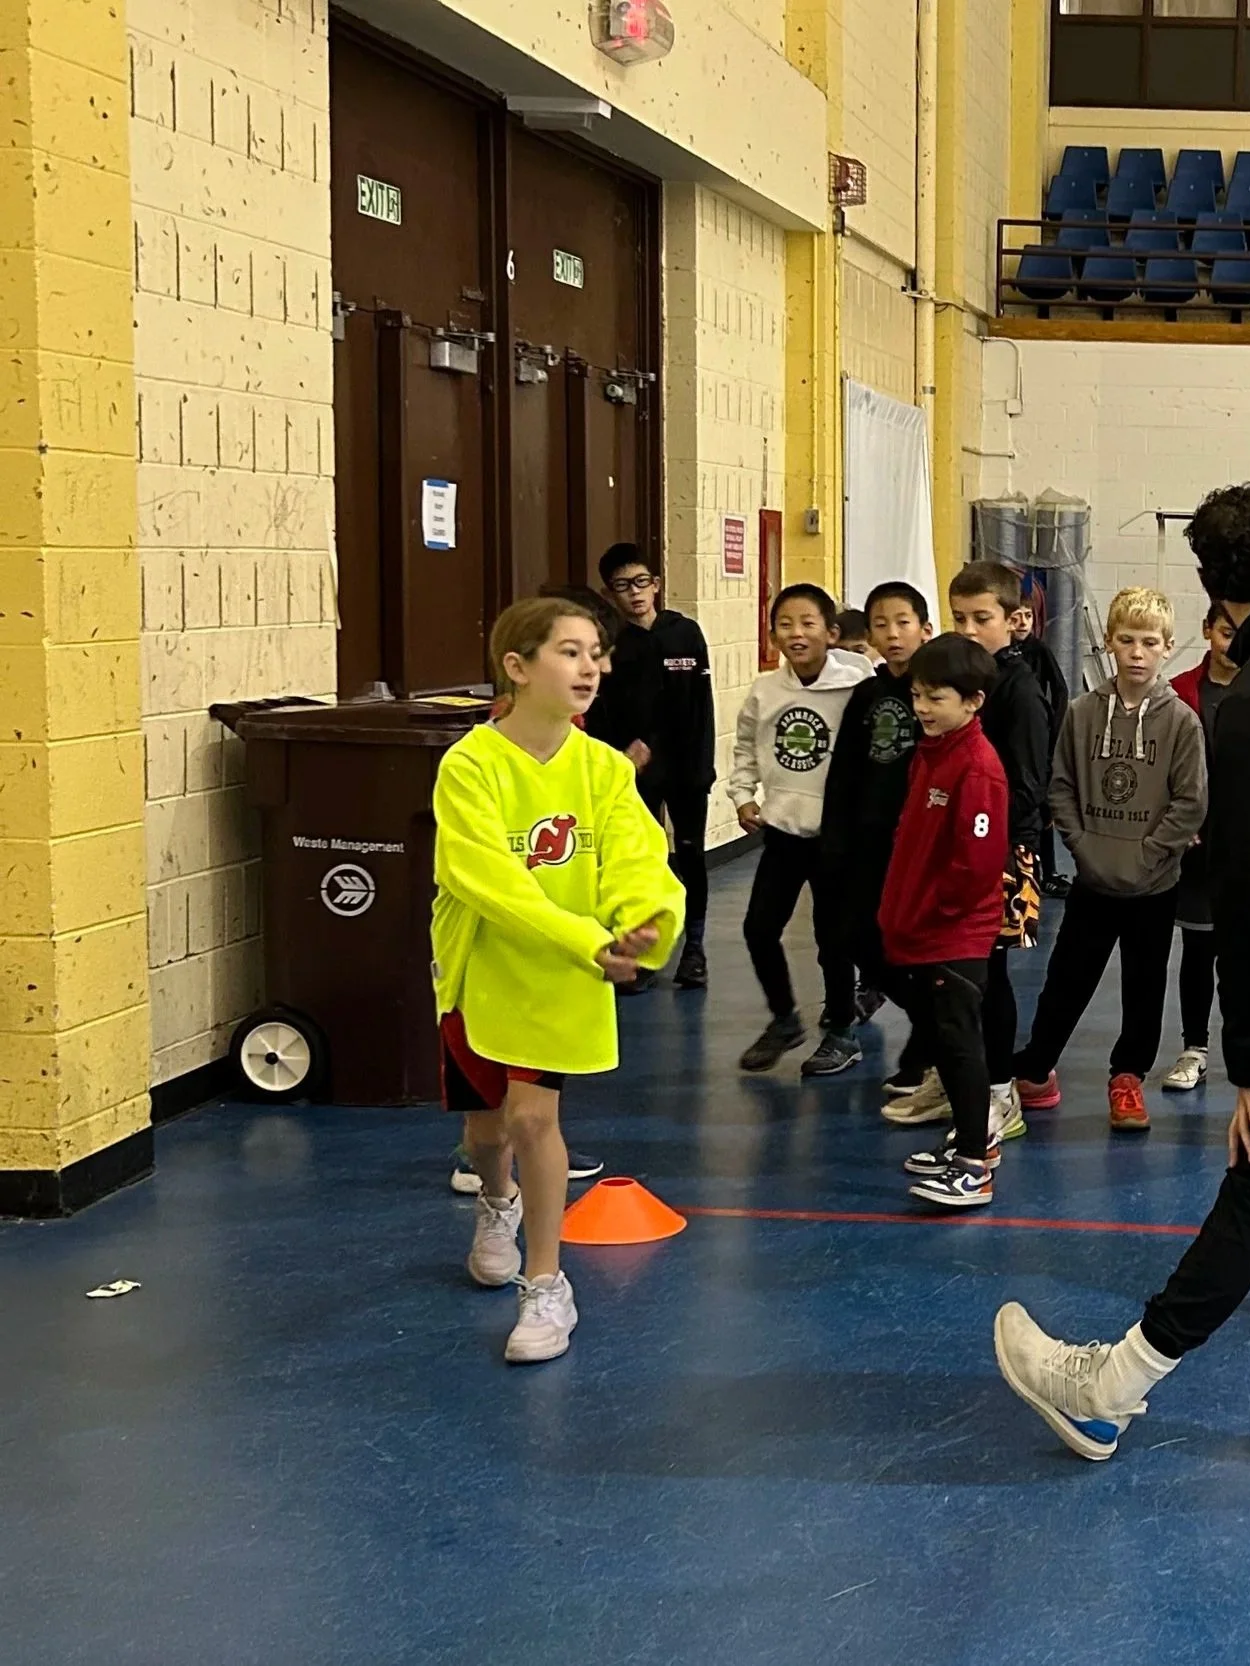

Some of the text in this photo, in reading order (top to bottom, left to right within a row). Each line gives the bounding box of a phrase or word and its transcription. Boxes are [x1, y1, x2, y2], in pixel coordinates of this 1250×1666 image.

[360, 177, 386, 218] EXIT
[506, 249, 515, 281] 6
[555, 252, 574, 283] EXIT
[974, 813, 989, 838] 8
[1128, 810, 1150, 822] ISLE
[292, 836, 405, 853] Waste Management
